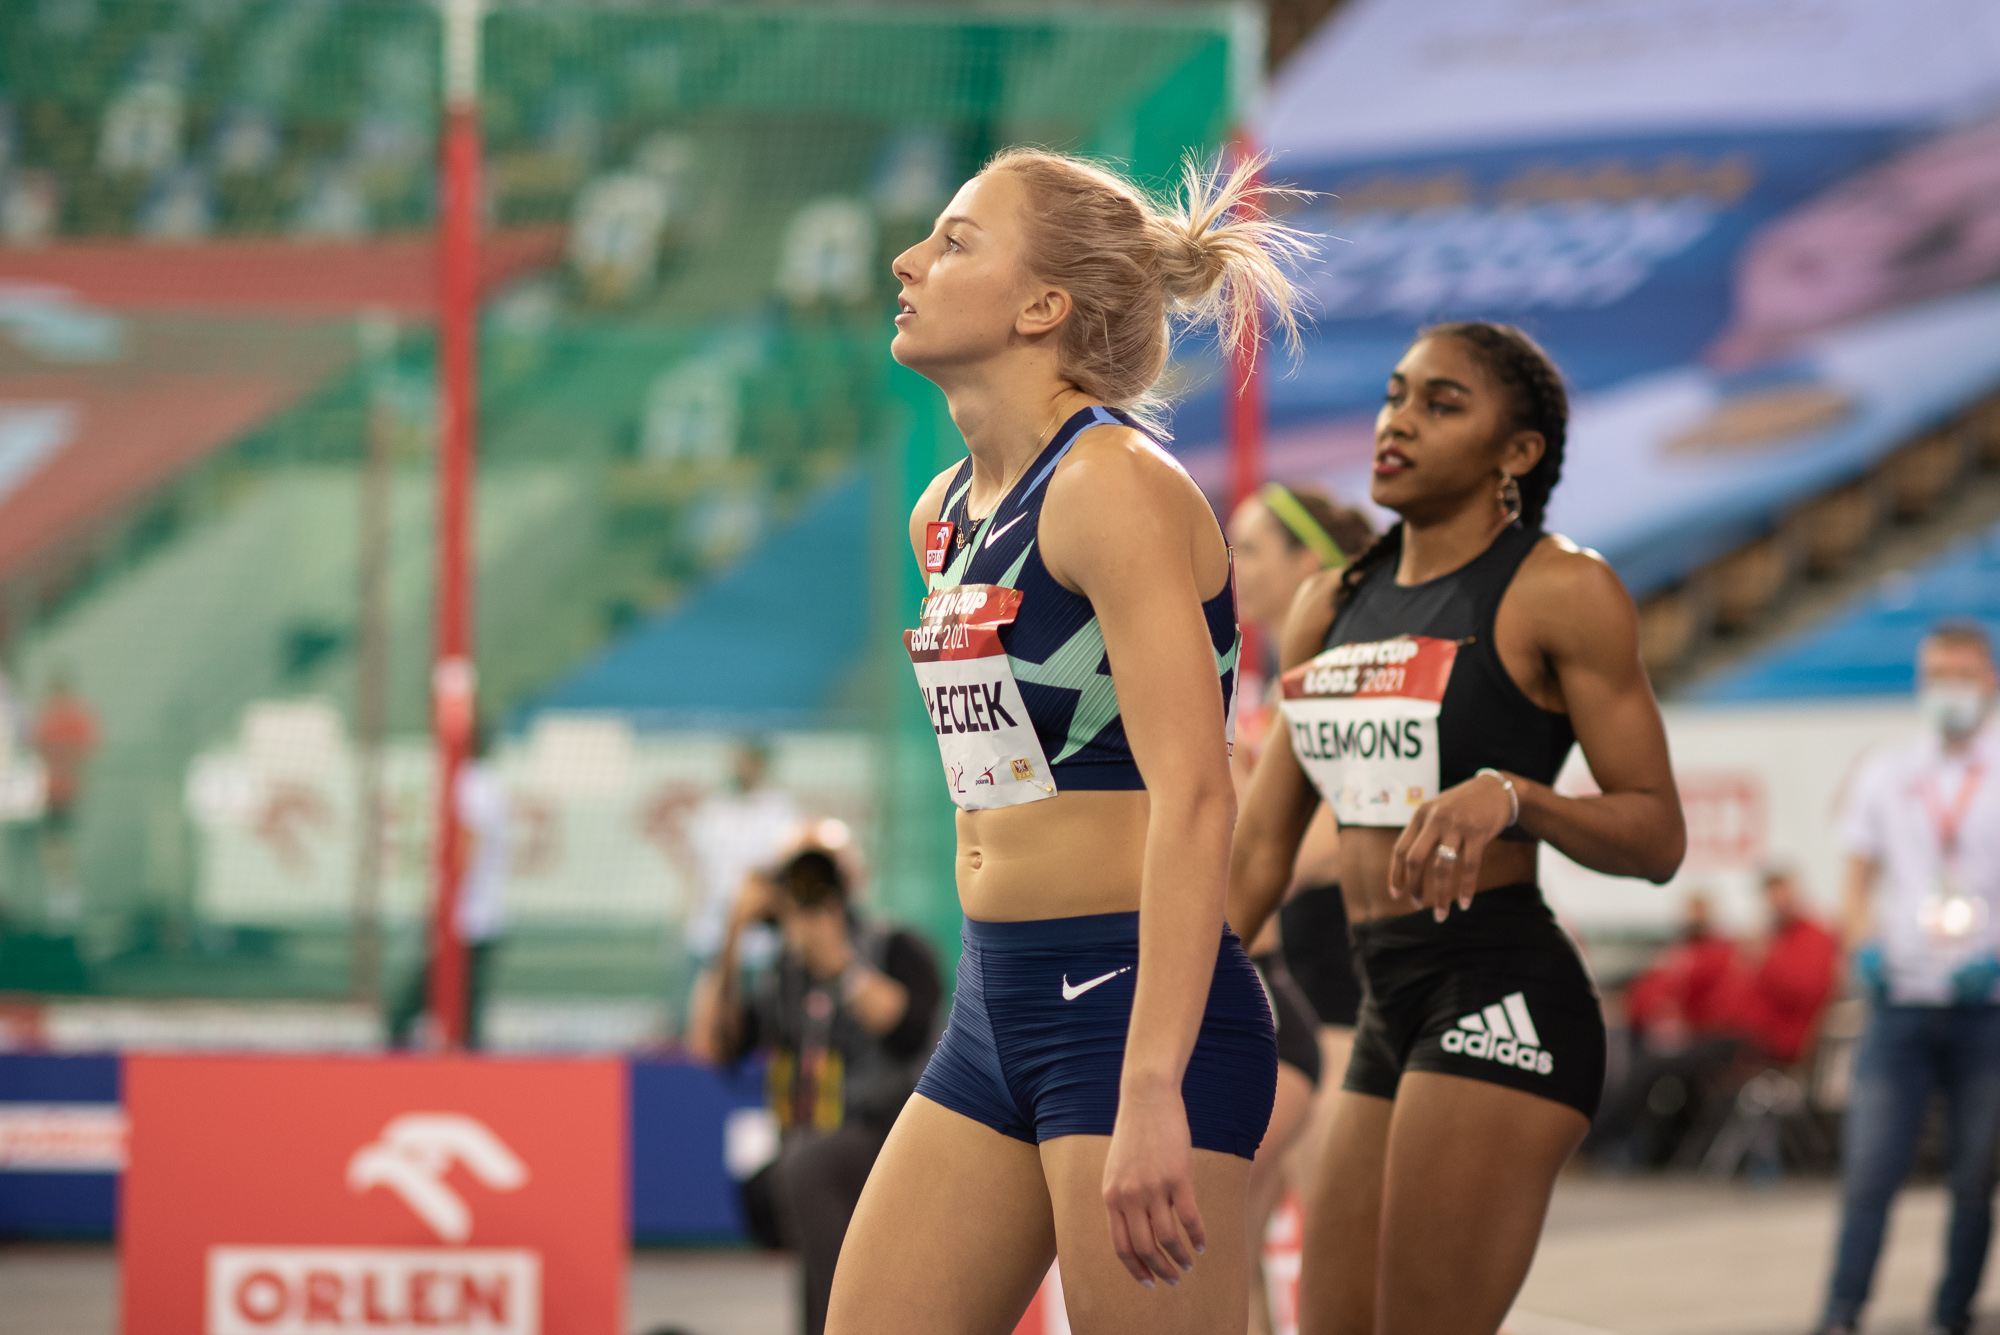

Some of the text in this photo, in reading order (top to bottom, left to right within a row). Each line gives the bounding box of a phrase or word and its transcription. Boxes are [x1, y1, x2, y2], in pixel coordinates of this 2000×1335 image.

[954, 591, 988, 615] CUP
[942, 624, 969, 650] 2021
[1375, 639, 1420, 665] CUP
[1360, 666, 1406, 693] 2021
[1294, 719, 1422, 760] CLEMONS
[1440, 1028, 1554, 1076] adidas
[233, 1266, 510, 1328] ORLEN
